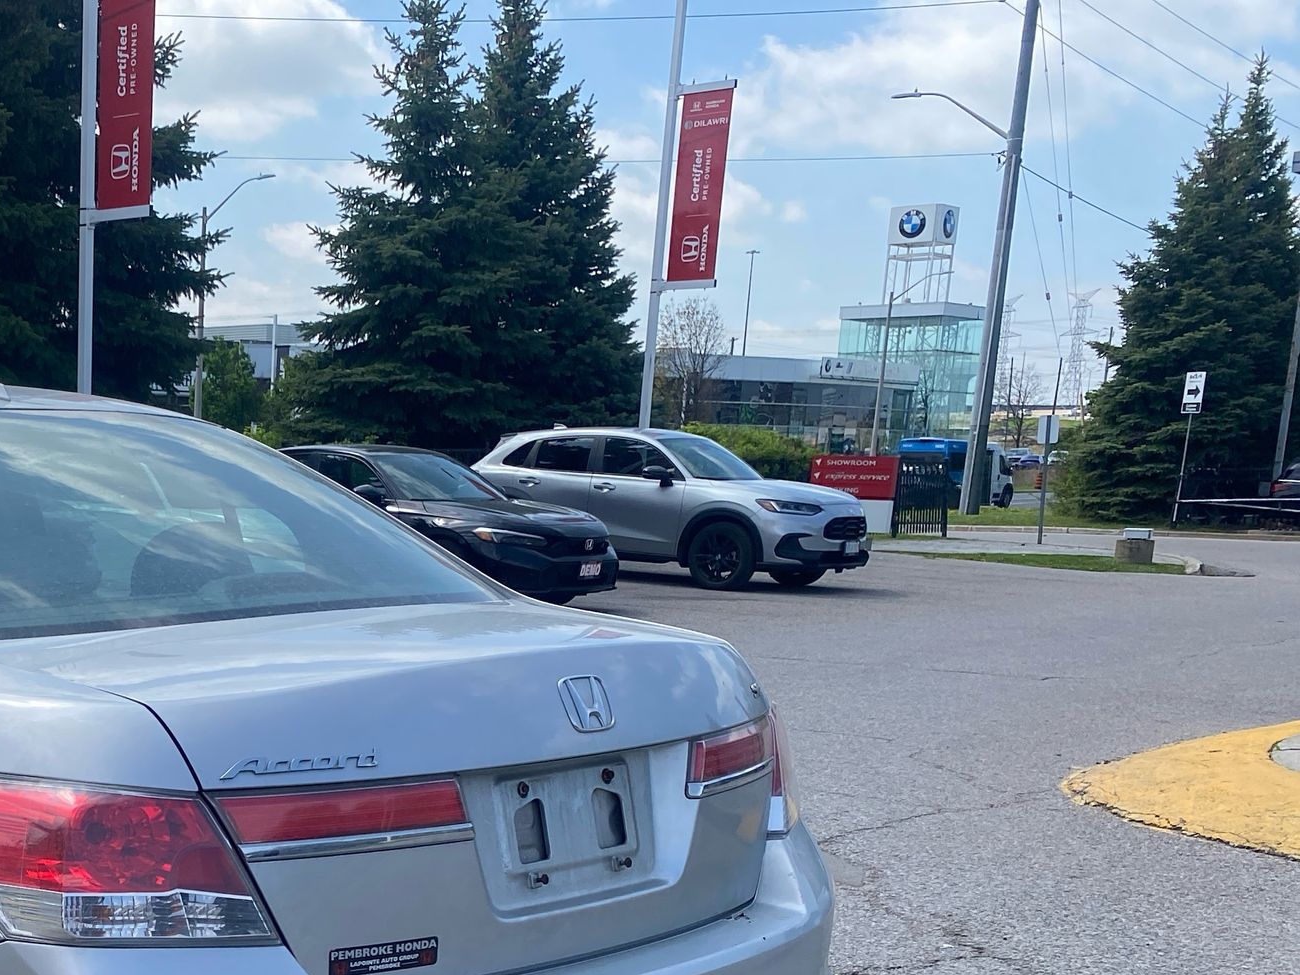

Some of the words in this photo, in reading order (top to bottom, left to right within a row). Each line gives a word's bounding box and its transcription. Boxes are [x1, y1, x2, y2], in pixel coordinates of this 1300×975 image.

[117, 25, 129, 97] Certified
[129, 23, 138, 95] PRE-OWNED
[693, 116, 729, 128] DILAWRI
[131, 126, 140, 192] HONDA
[690, 149, 703, 202] Certified
[701, 147, 713, 201] PRE-OWNED
[699, 224, 710, 272] HONDA
[827, 459, 877, 467] SHOWROOM
[580, 563, 601, 577] DEMO
[219, 747, 378, 781] Accord
[331, 944, 394, 961] PEMBROKE
[396, 939, 437, 953] HONDA
[350, 958, 380, 968] LAPOINTE
[381, 956, 398, 964] AUTO
[399, 953, 419, 962] GROUP
[369, 962, 401, 972] PEMBROKE
